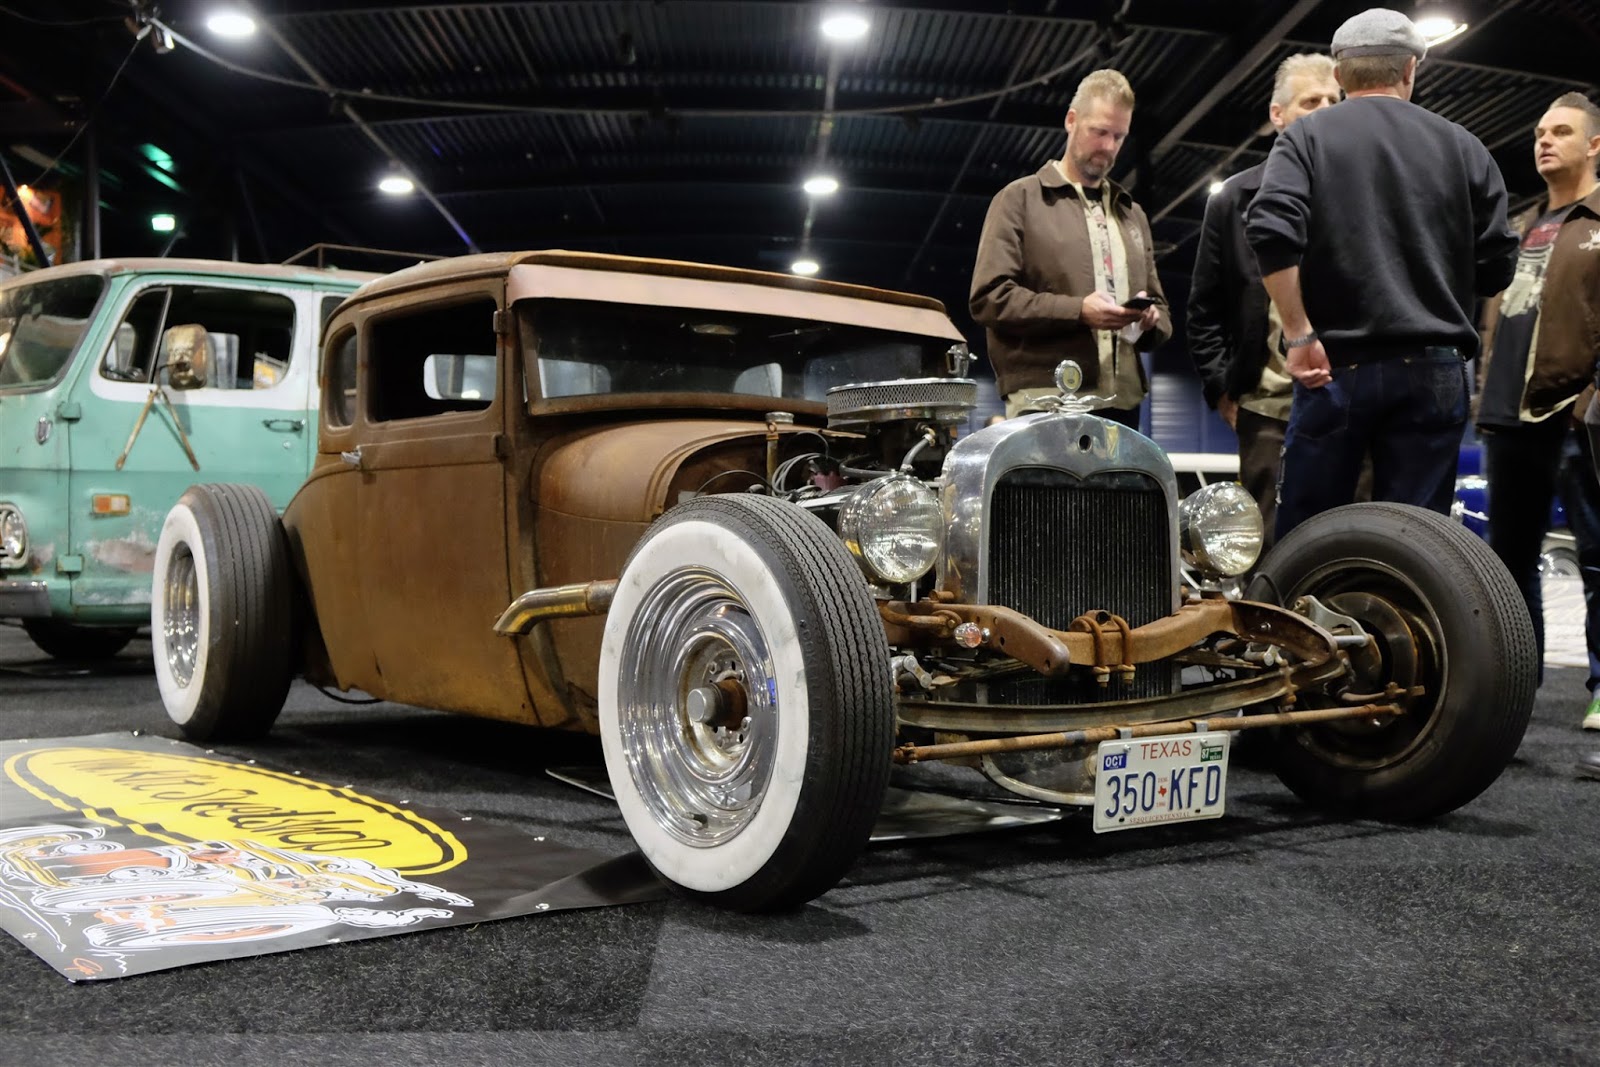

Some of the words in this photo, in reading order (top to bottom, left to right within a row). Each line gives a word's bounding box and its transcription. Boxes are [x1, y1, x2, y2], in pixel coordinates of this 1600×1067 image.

[1140, 739, 1192, 760] TEXAS
[1201, 748, 1210, 760] 87
[1105, 755, 1123, 768] OCT
[1105, 771, 1156, 818] 350
[1169, 765, 1221, 811] KFD
